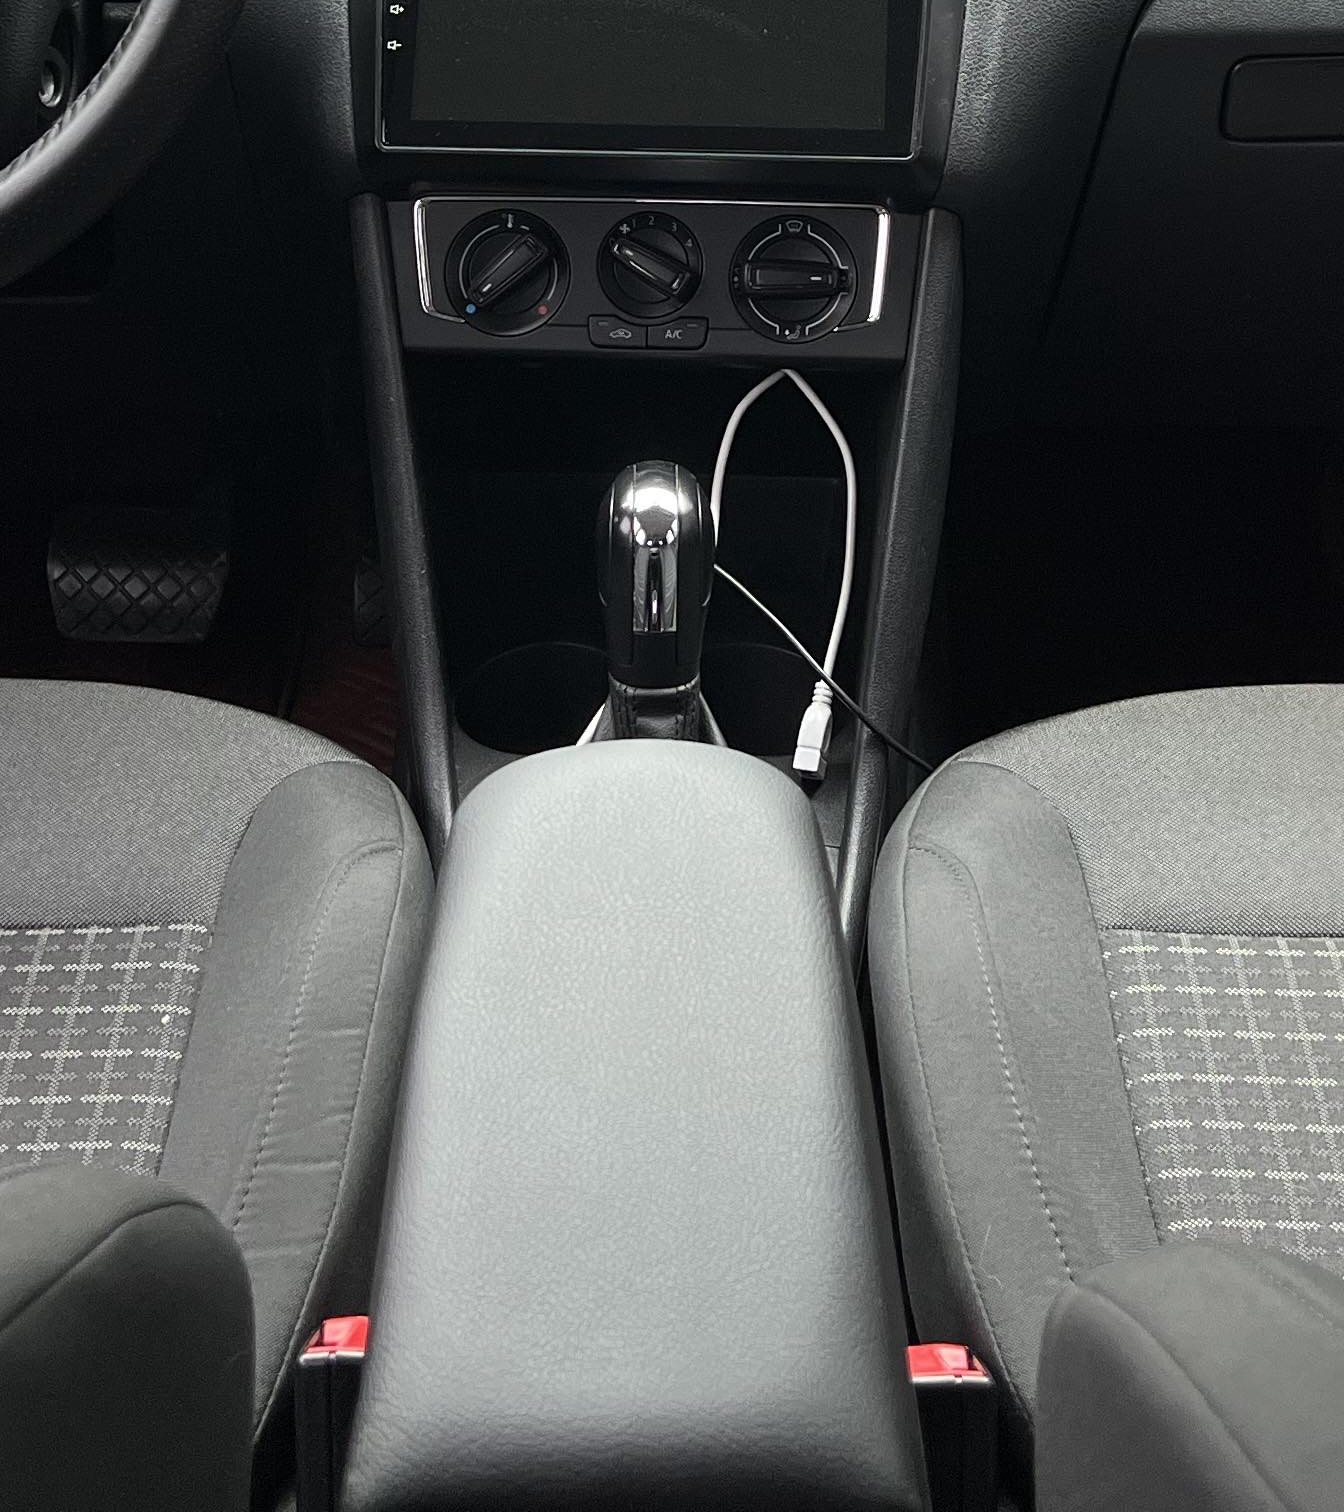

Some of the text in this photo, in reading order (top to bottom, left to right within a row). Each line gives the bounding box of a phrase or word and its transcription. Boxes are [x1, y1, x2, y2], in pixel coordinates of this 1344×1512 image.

[648, 216, 655, 226] 2
[671, 222, 677, 232] 3
[664, 329, 683, 340] A/C
